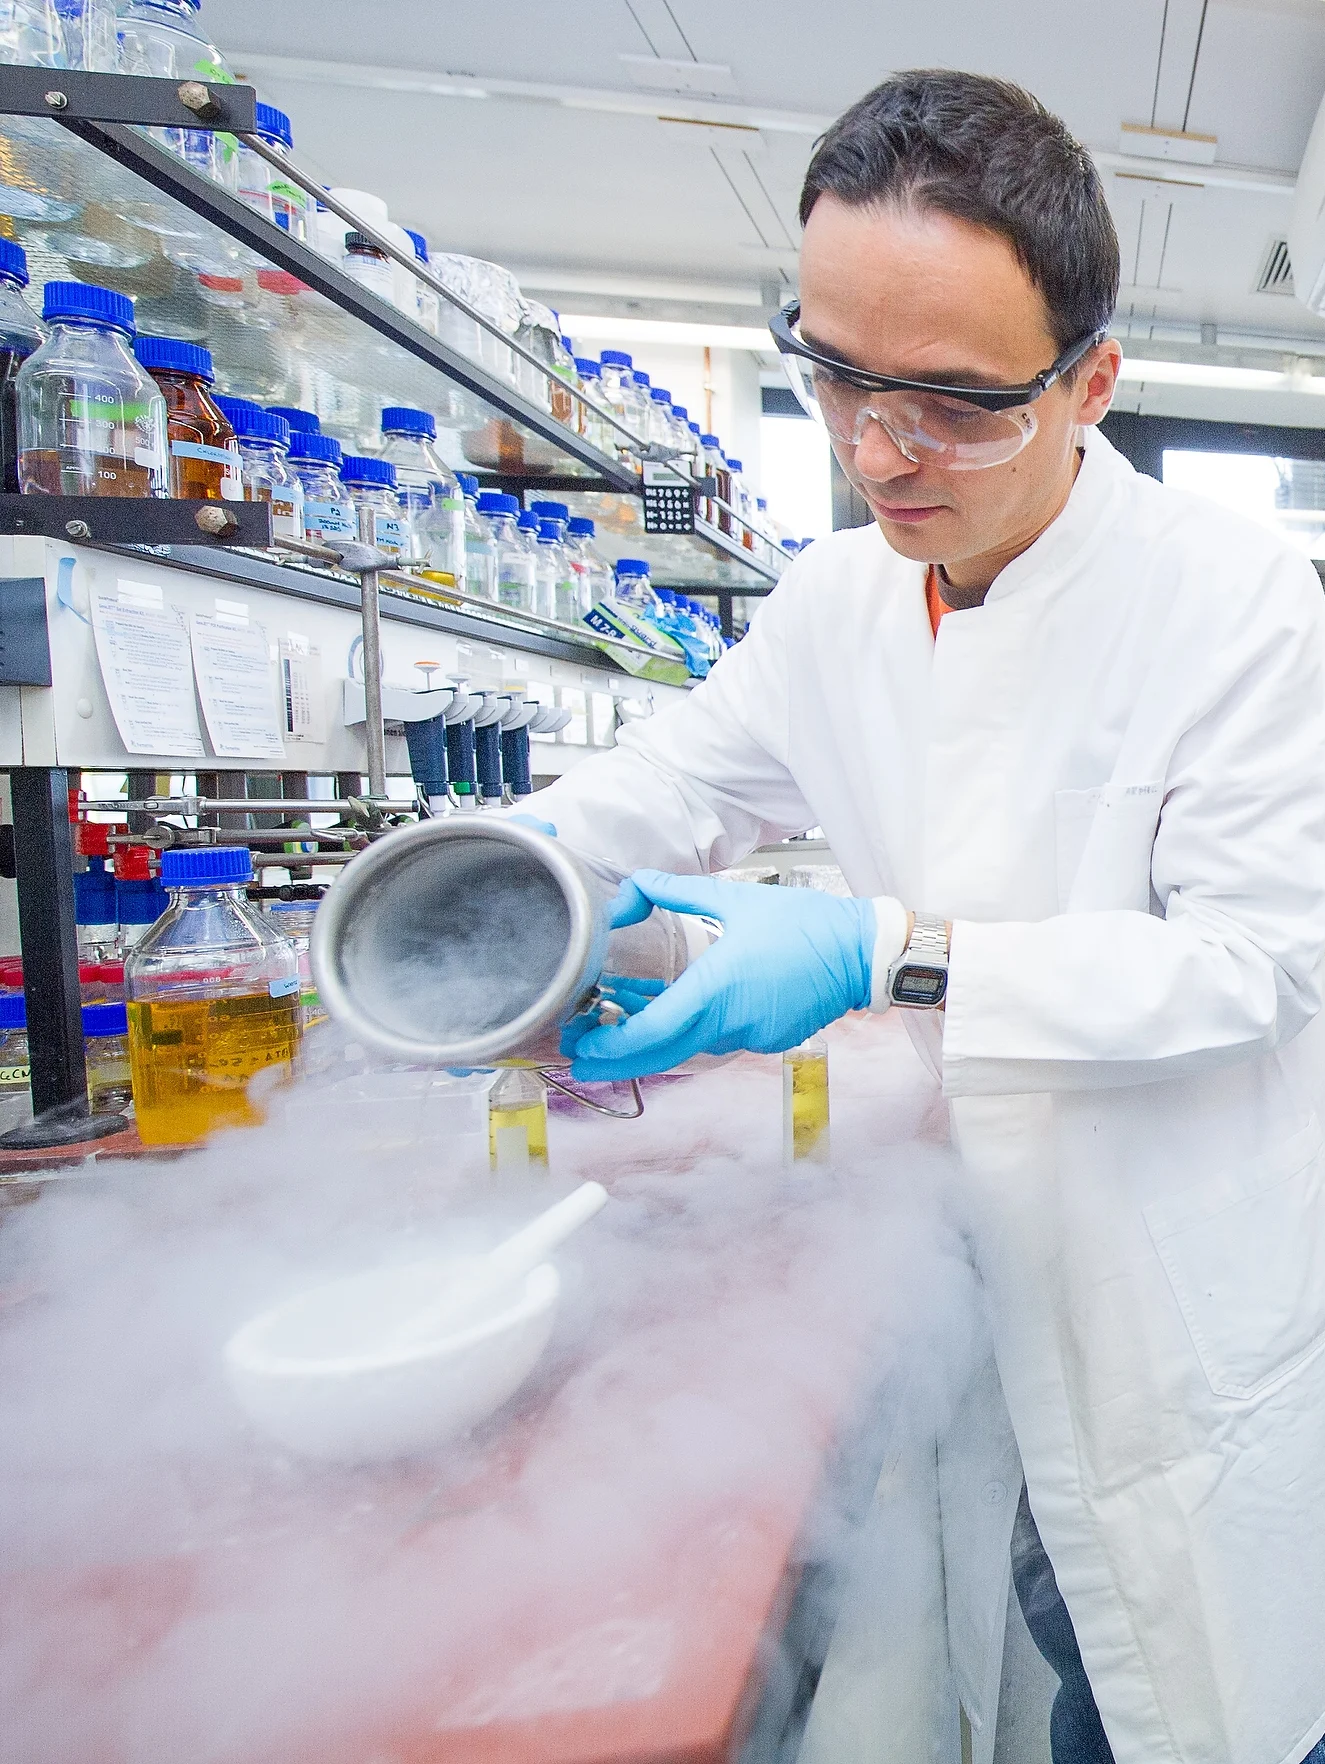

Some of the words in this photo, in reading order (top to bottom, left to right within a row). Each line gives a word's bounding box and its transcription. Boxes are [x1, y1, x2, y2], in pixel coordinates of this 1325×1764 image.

[94, 394, 115, 404] 400
[95, 419, 115, 429] 300
[97, 470, 117, 480] 100
[657, 488, 665, 498] 7
[330, 507, 341, 517] P2
[660, 511, 666, 520] 1
[667, 511, 674, 520] 2
[675, 511, 682, 520] 3
[386, 522, 400, 531] N3
[590, 614, 603, 628] M
